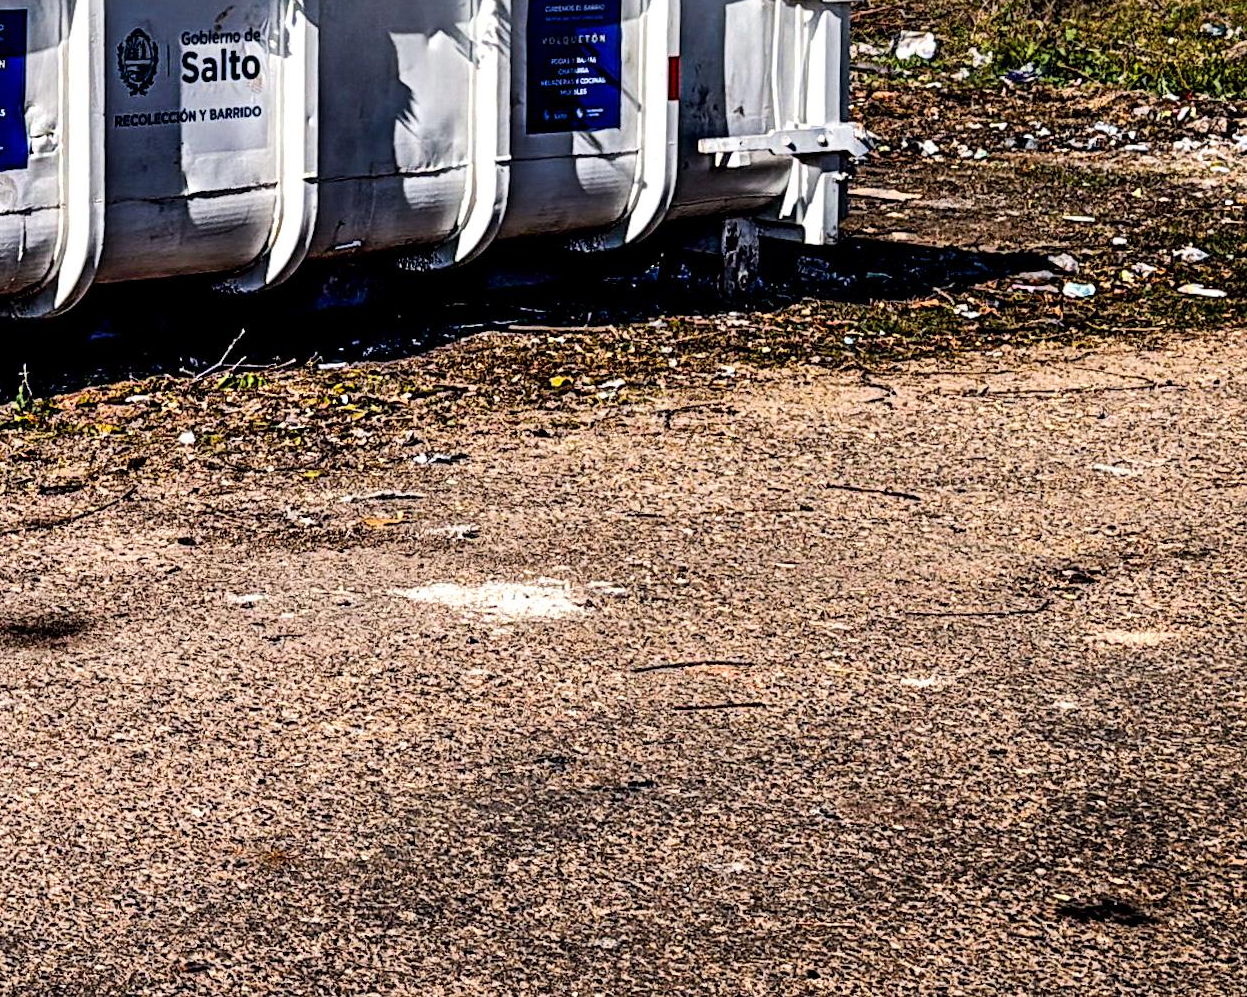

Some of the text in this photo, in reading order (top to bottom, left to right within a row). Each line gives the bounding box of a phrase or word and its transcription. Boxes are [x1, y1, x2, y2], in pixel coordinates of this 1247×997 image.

[181, 27, 261, 46] Gobierno de
[181, 48, 261, 84] Salto
[114, 105, 262, 128] RECOLECCIÓN Y BARRIDO
